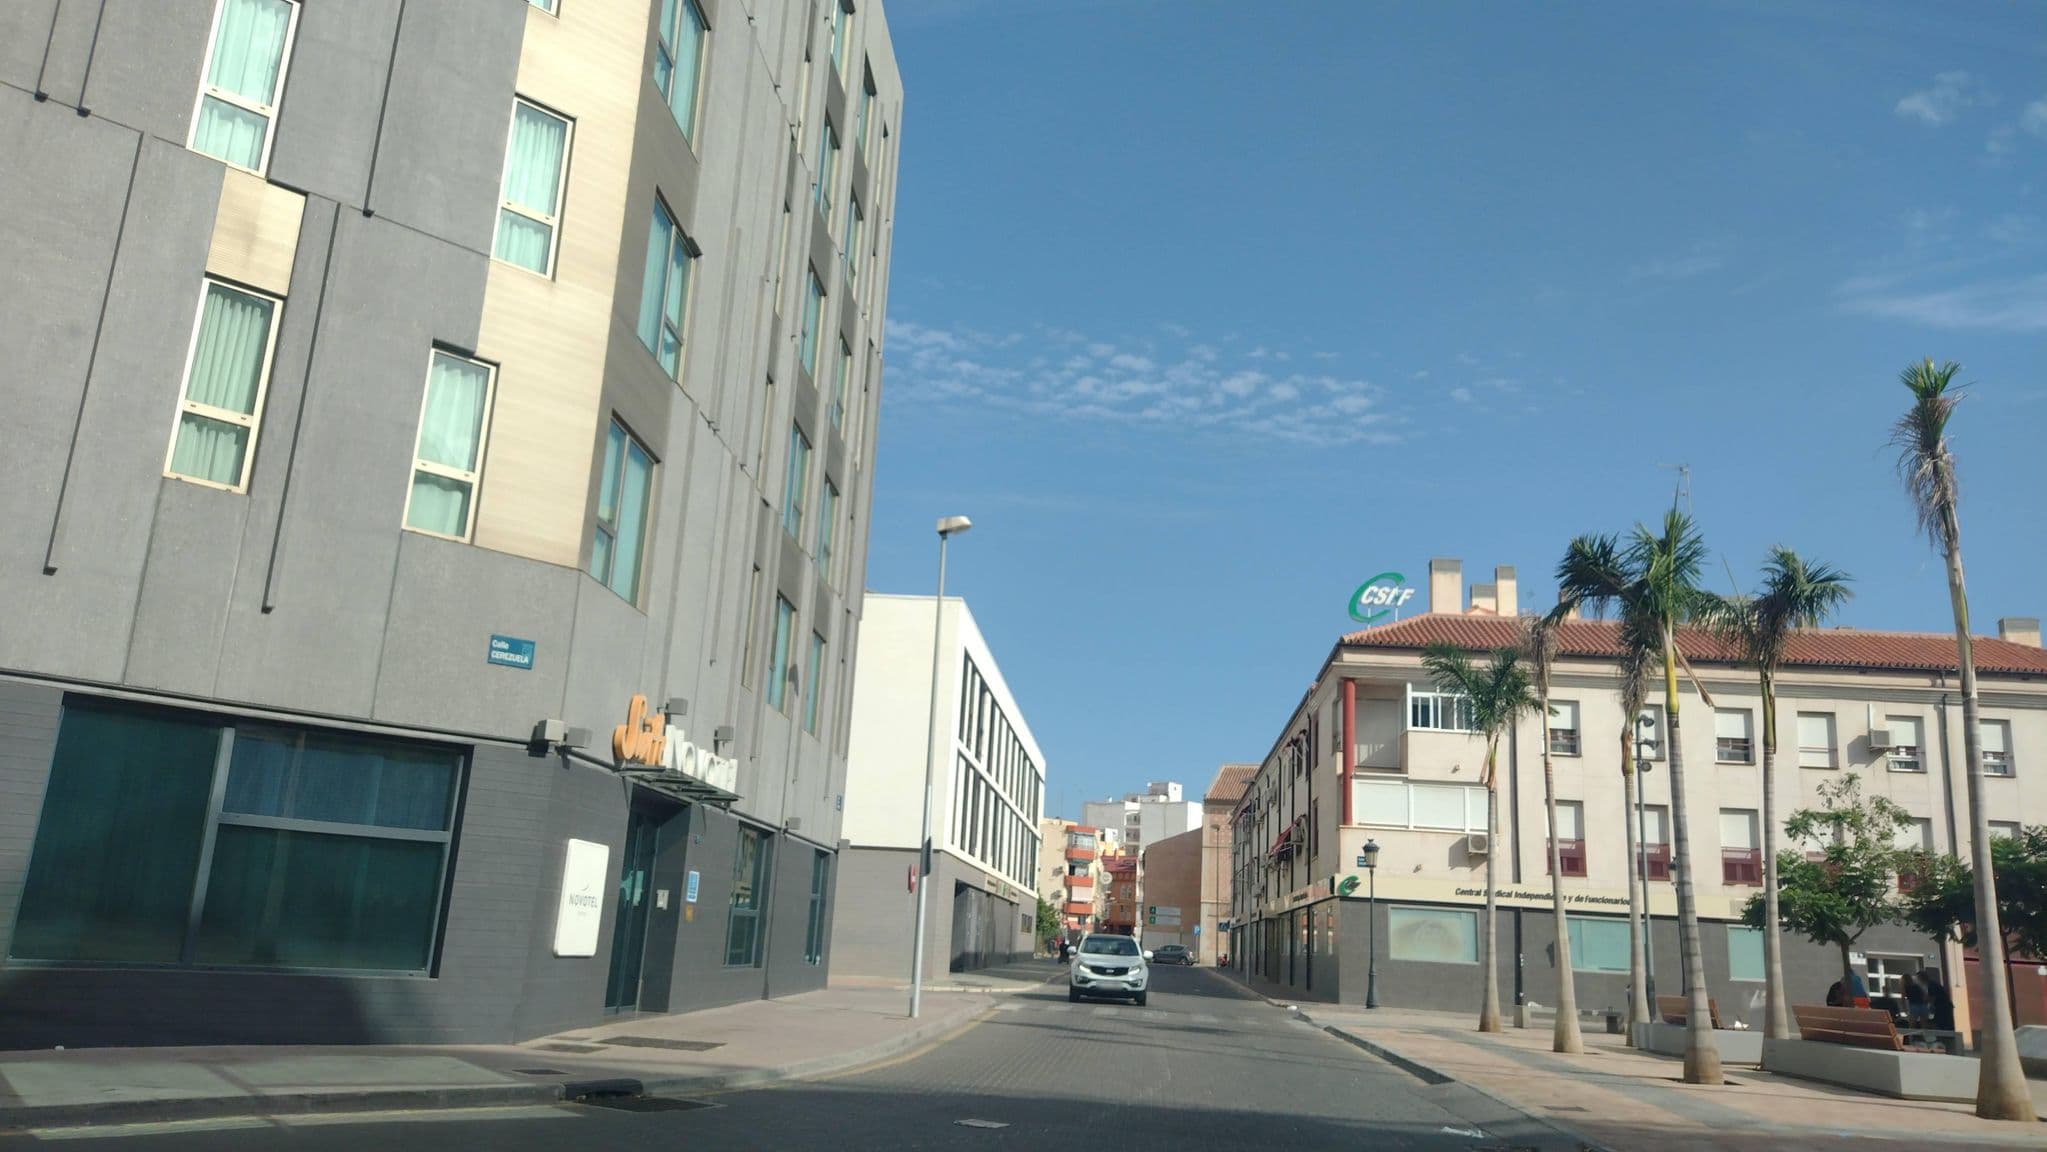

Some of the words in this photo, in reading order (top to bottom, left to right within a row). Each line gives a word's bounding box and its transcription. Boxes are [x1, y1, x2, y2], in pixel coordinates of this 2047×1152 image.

[492, 639, 510, 650] Calle
[491, 650, 530, 665] CEREZUELA
[568, 892, 599, 909] NOVOTEL
[1455, 887, 1482, 897] Central
[1483, 889, 1513, 898] Sdical
[1567, 895, 1574, 904] y
[1574, 894, 1584, 903] de
